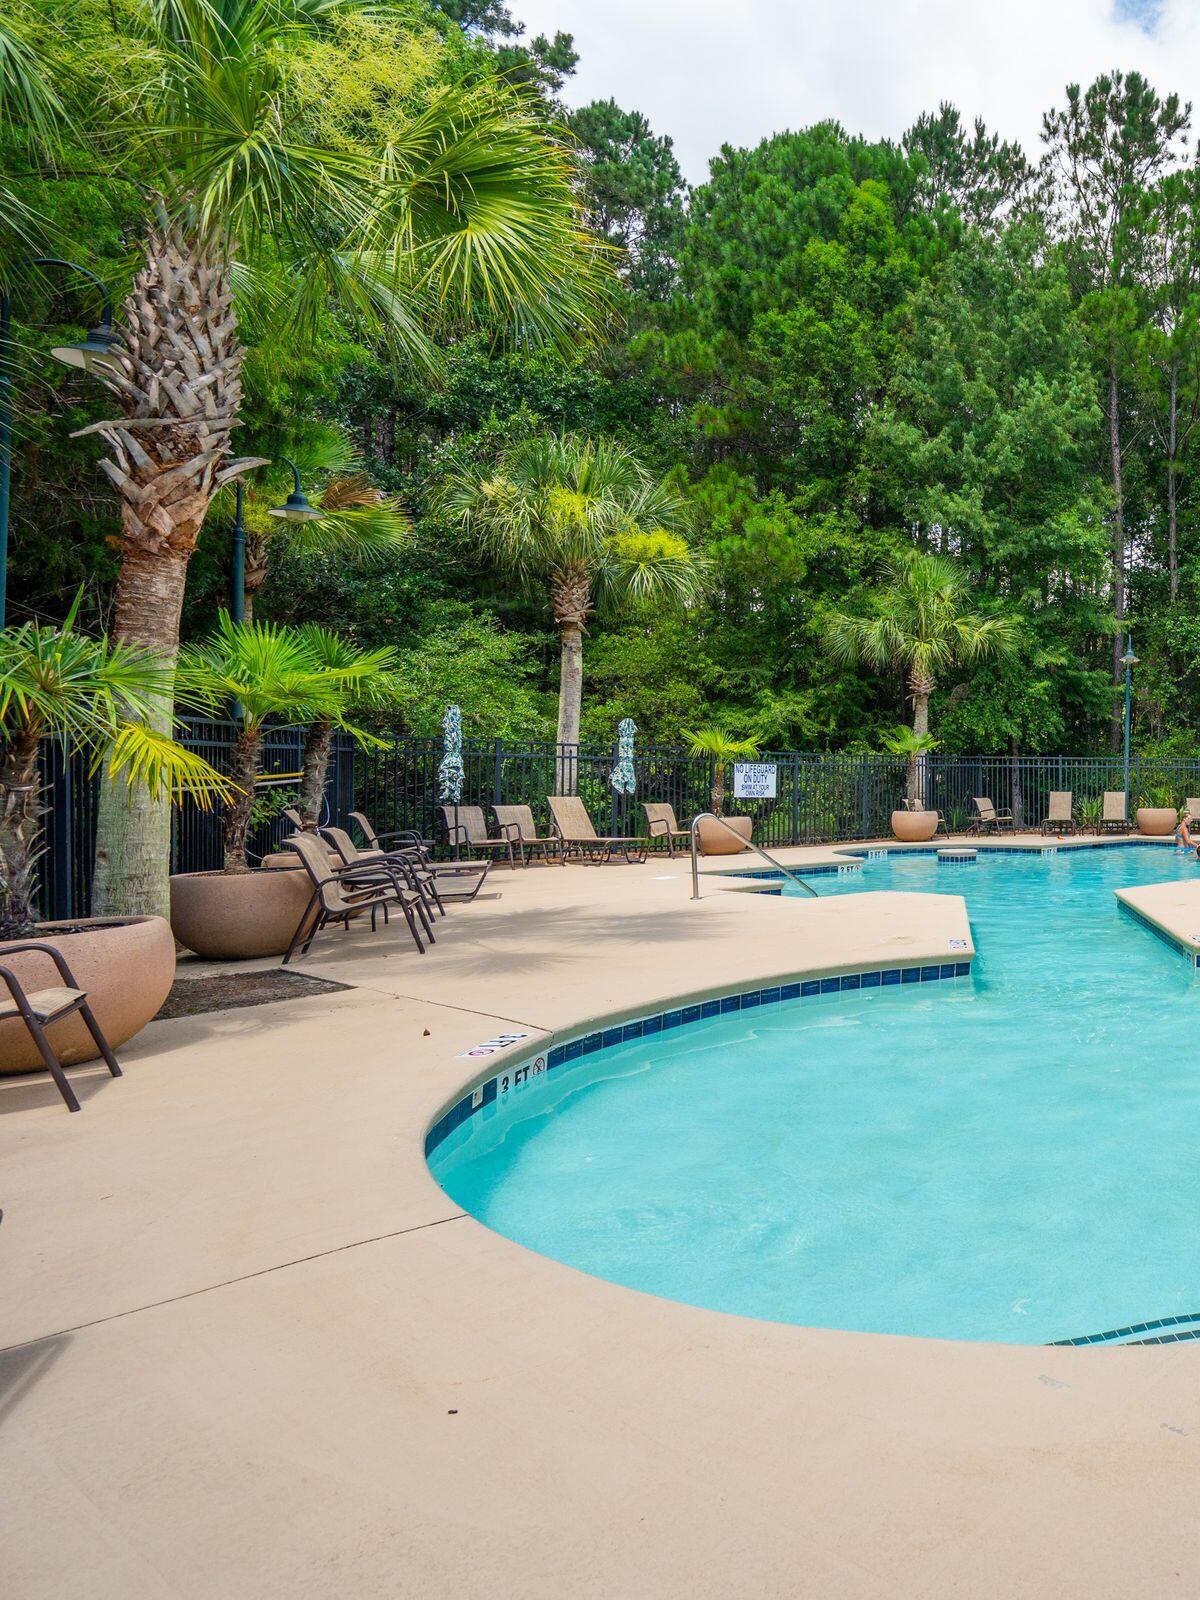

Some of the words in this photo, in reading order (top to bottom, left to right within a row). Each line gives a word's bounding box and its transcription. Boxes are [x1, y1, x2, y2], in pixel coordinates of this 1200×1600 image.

[736, 764, 744, 774] NO
[745, 764, 775, 774] LIFEGUARD
[744, 774, 752, 783] ON
[753, 774, 768, 783] DUTY
[501, 1076, 509, 1094] 3
[514, 1065, 530, 1086] FT
